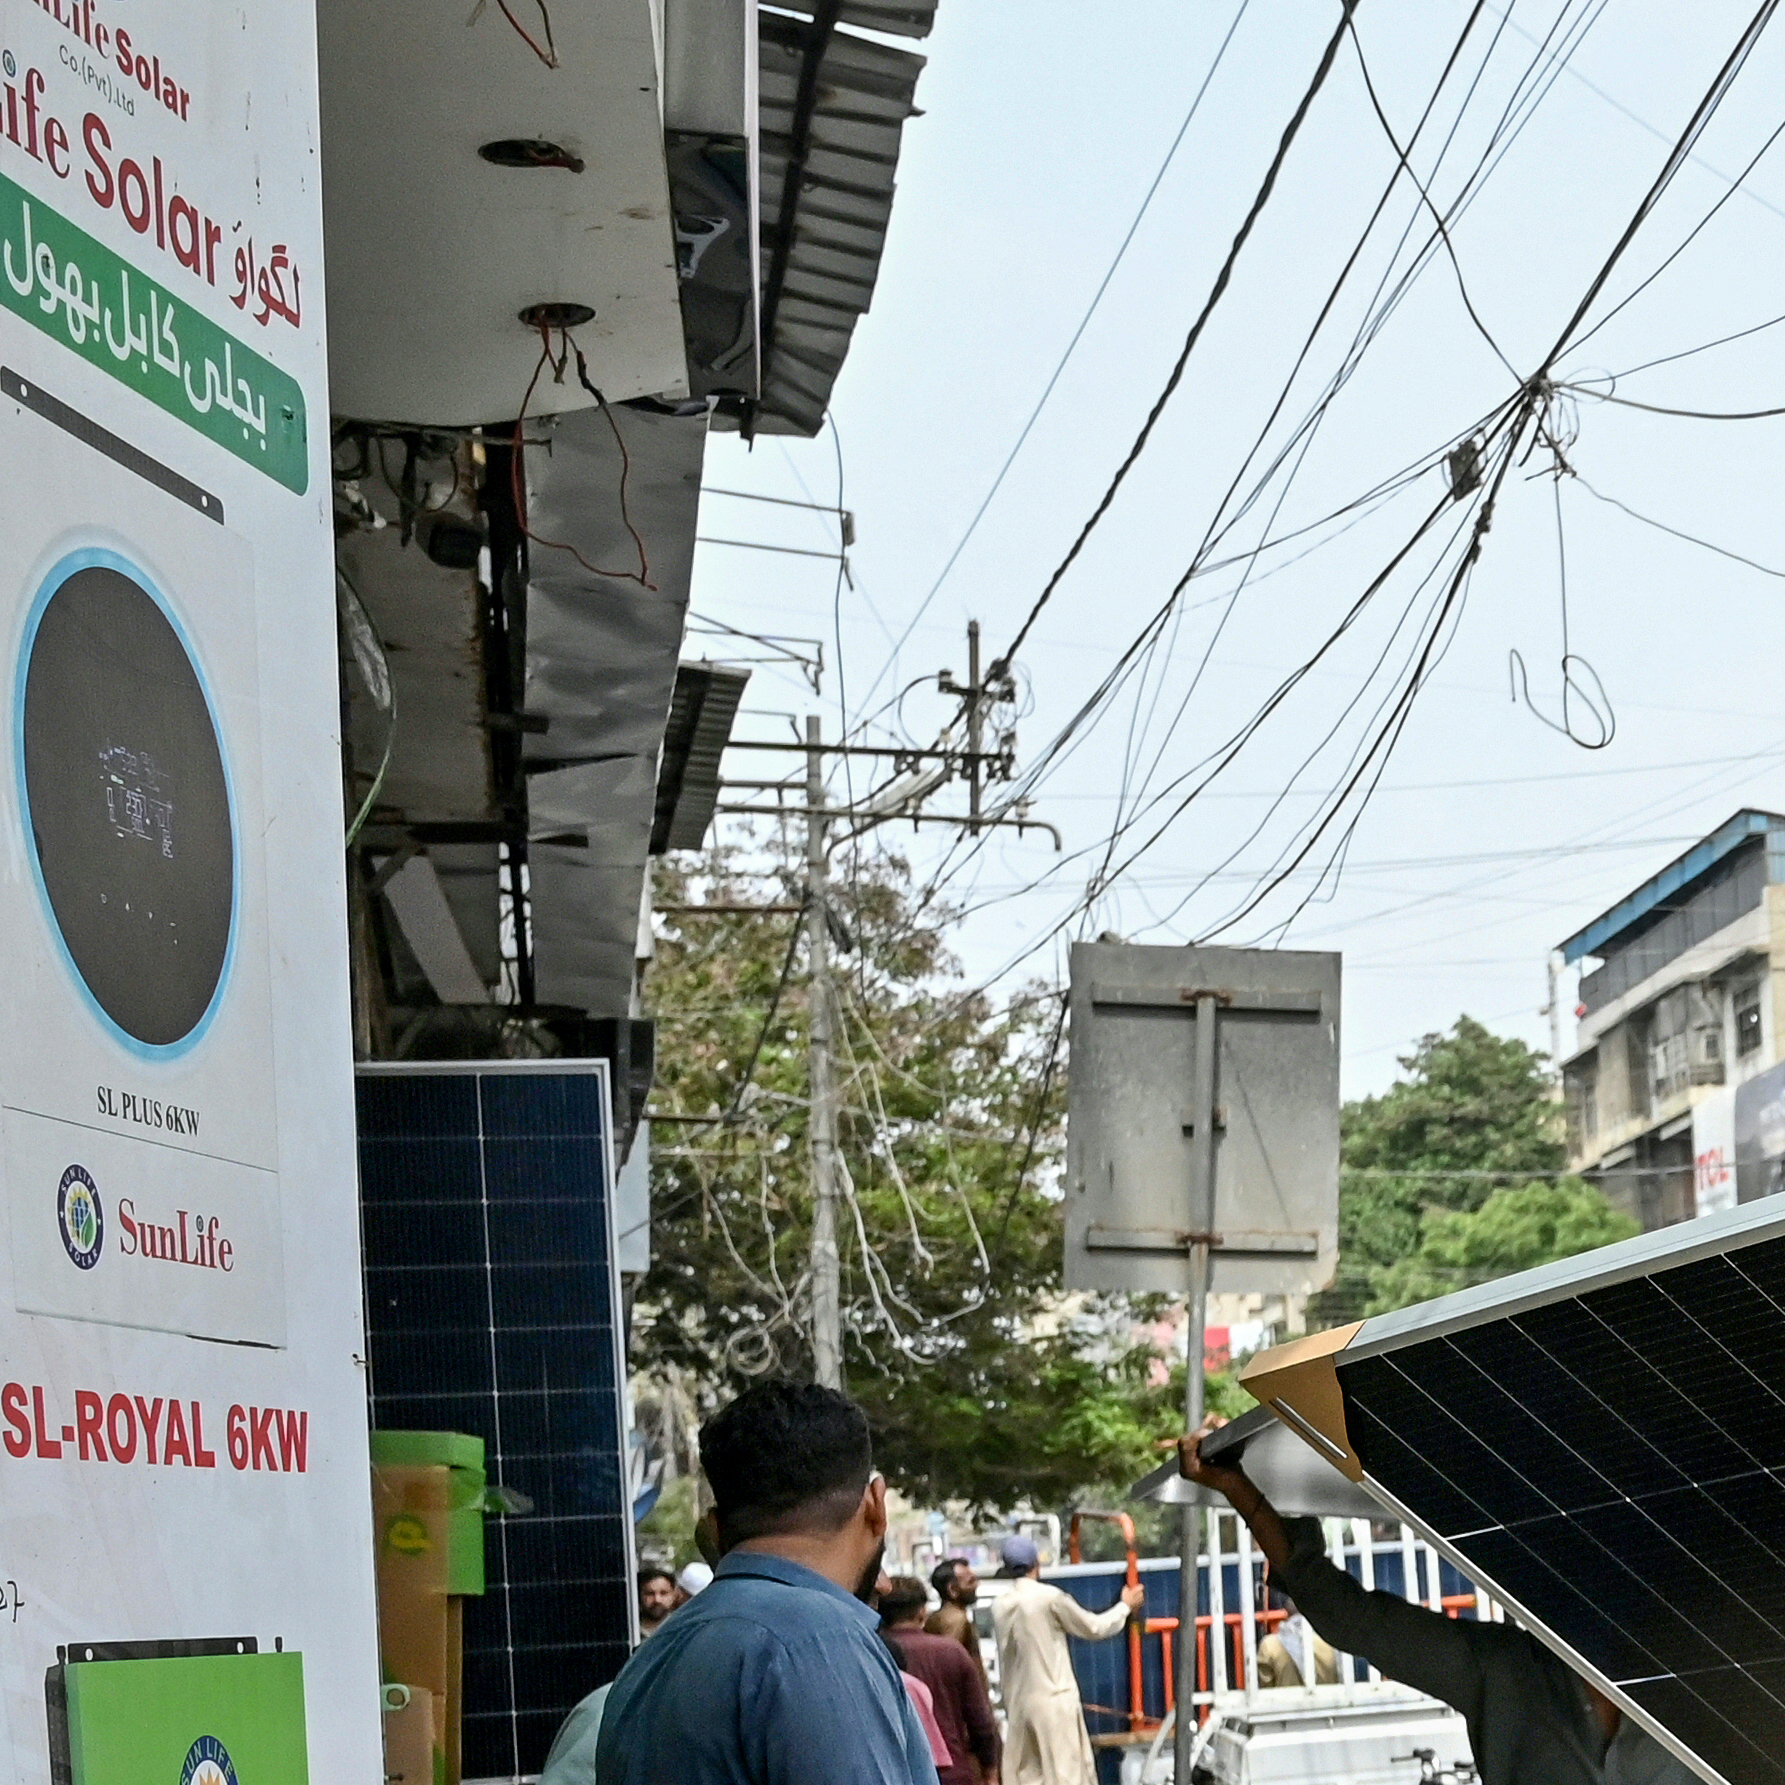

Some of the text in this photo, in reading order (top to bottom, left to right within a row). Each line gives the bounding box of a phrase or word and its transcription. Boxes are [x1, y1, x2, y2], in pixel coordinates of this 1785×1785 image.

[115, 27, 191, 122] Solar
[0, 49, 222, 287] ife Solar
[97, 1086, 201, 1137] SL PLUS 6KW
[118, 1197, 235, 1273] SunLife
[1, 1381, 308, 1473] SL-ROYAL 6KW
[206, 1737, 234, 1783] LIFE
